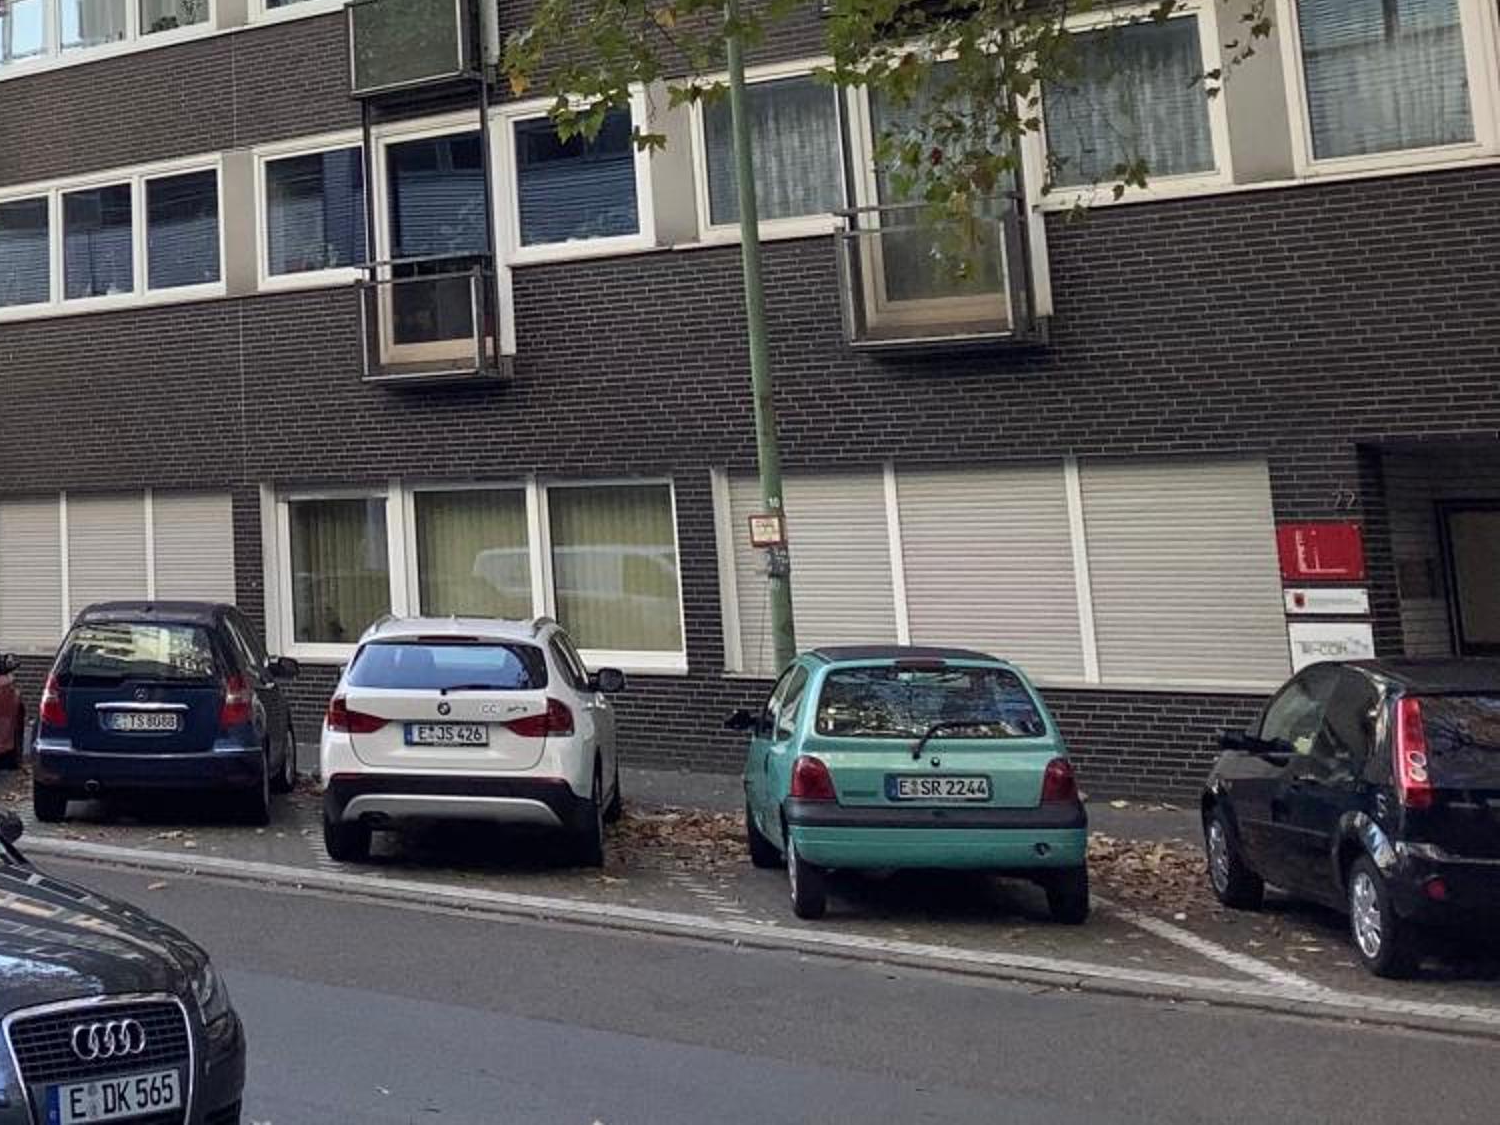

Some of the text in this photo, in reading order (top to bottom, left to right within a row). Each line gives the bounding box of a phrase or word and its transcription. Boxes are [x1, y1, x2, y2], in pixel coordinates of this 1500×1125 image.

[418, 726, 483, 741] E JS 426
[899, 780, 986, 795] E SR 2244
[70, 1074, 173, 1118] E DK 565
